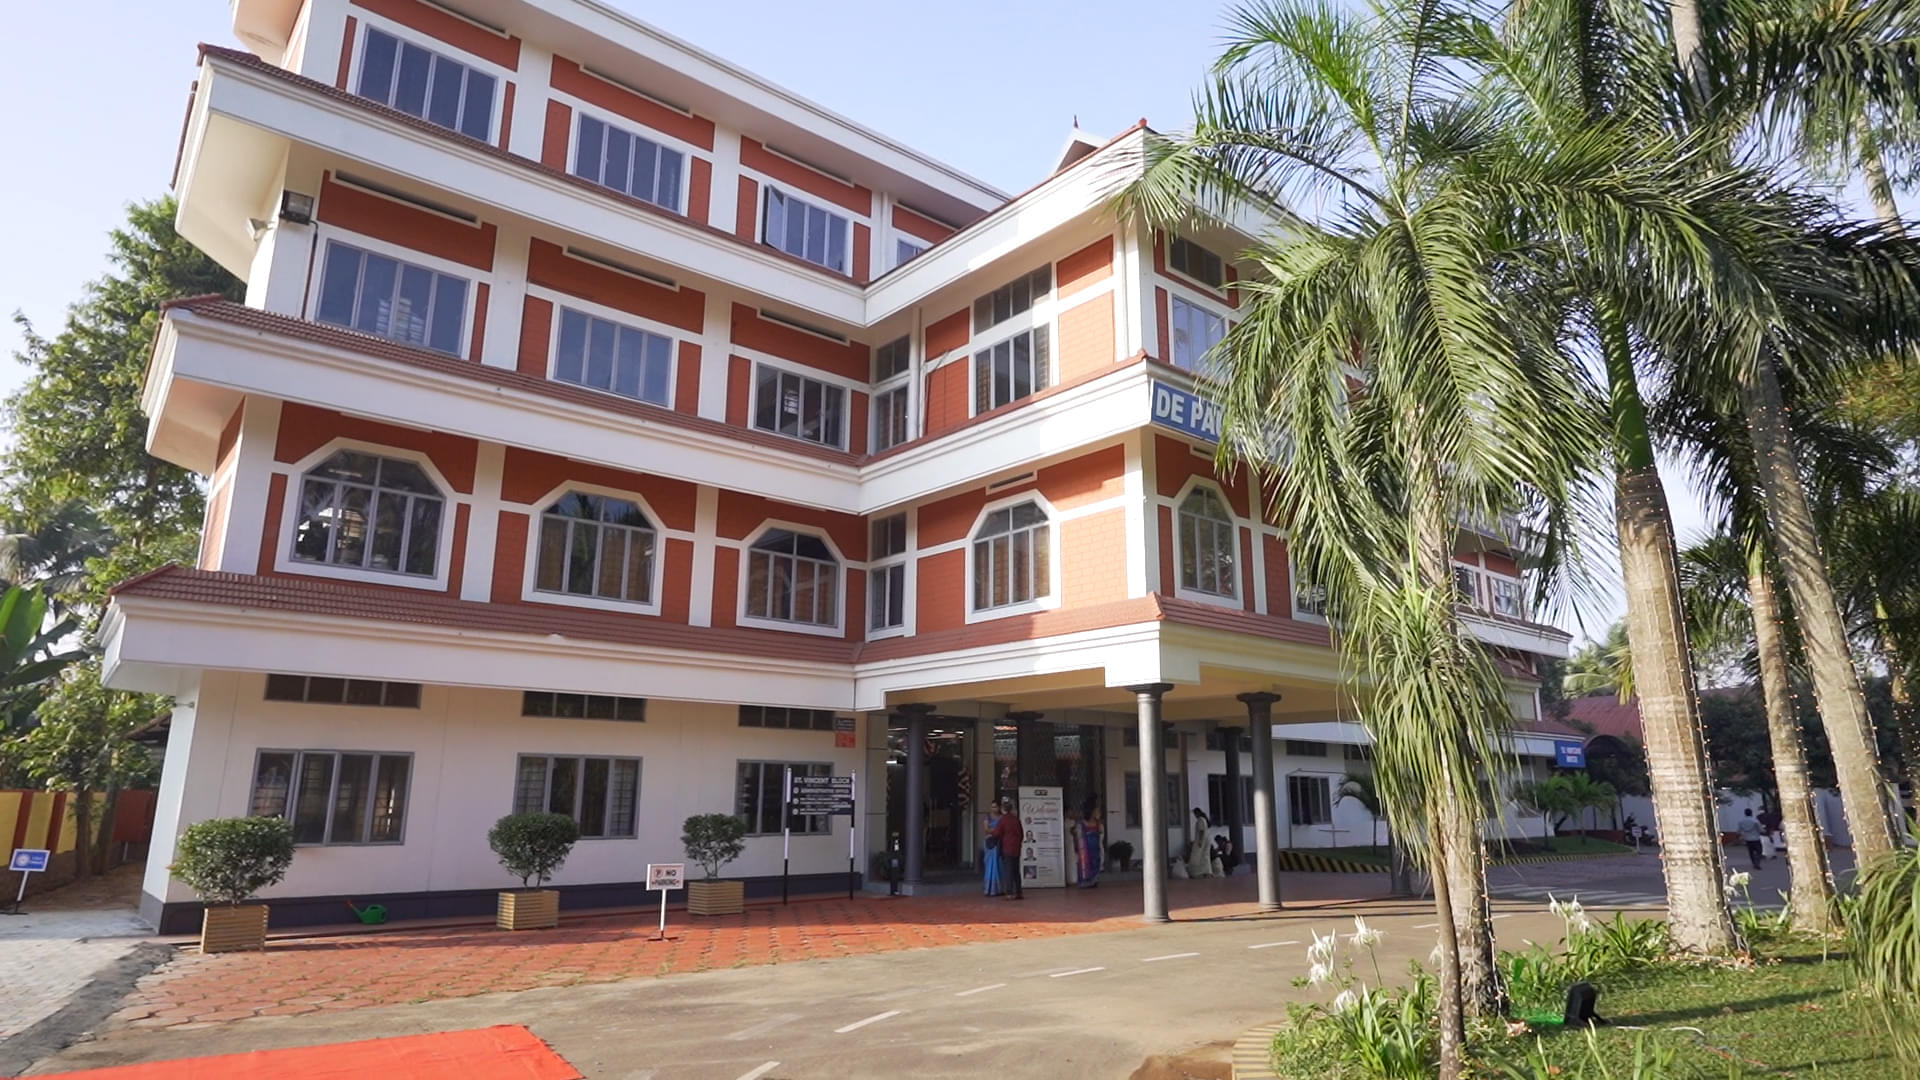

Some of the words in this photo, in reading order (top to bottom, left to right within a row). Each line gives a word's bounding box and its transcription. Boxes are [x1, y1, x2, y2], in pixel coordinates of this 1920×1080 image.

[1154, 386, 1185, 425] DE
[666, 869, 677, 877] NO
[655, 878, 677, 886] PARKING
